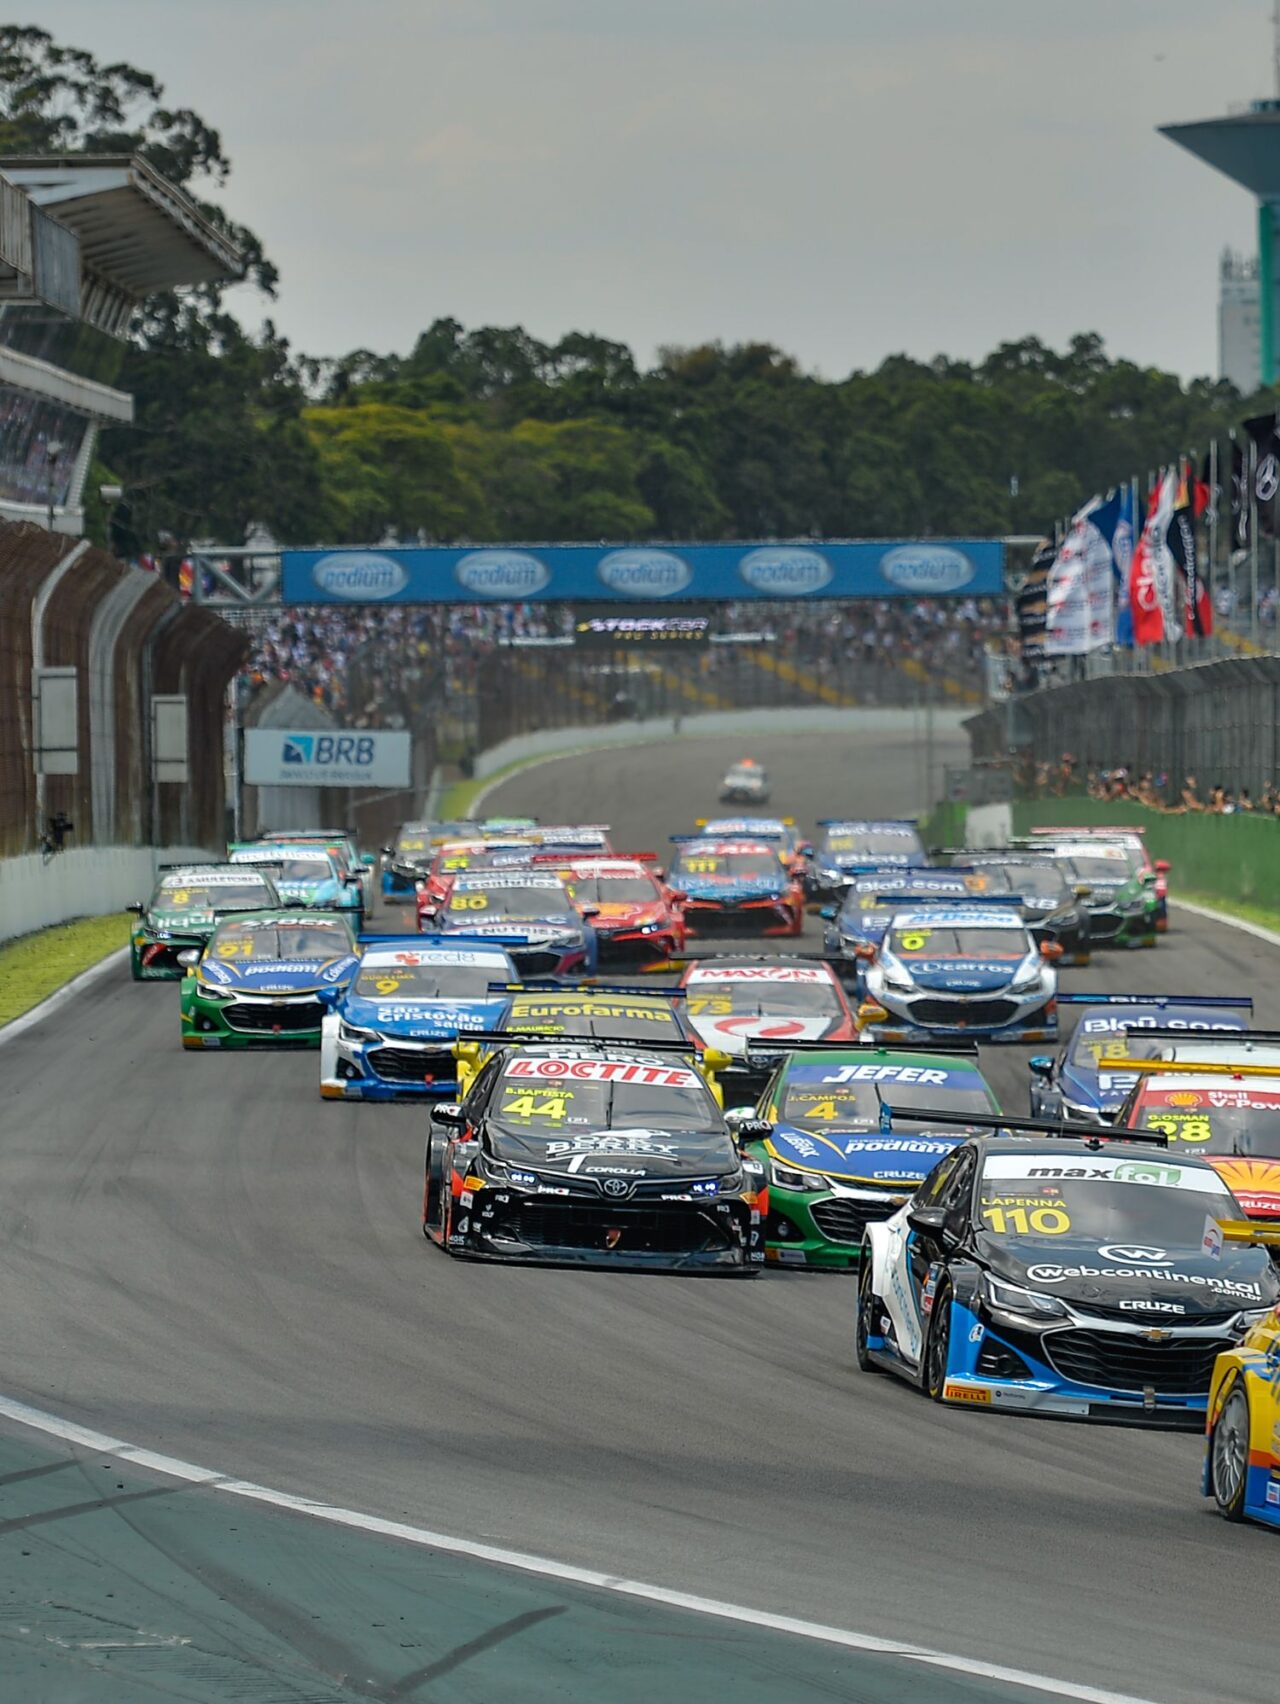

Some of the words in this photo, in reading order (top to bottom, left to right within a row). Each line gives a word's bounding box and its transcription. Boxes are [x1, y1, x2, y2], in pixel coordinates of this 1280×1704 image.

[316, 736, 374, 764] BRB
[376, 980, 399, 996] 9
[511, 1004, 672, 1022] Eurofarma
[688, 1000, 732, 1016] 73
[1087, 1044, 1130, 1060] 18
[508, 1061, 694, 1086] LOCTITE
[822, 1065, 949, 1084] JEFER
[505, 1087, 574, 1099] B.BAPTISTA
[789, 1094, 857, 1102] J.CAMPOS
[1208, 1091, 1248, 1101] Shell
[502, 1097, 566, 1119] 44
[804, 1101, 839, 1120] 4
[1147, 1121, 1212, 1142] 28
[585, 1166, 646, 1176] COROLLA
[981, 1197, 1067, 1208] LAPENNA
[982, 1207, 1071, 1235] 110
[1119, 1300, 1186, 1315] CRUZE
[946, 1385, 987, 1401] PIRELLI
